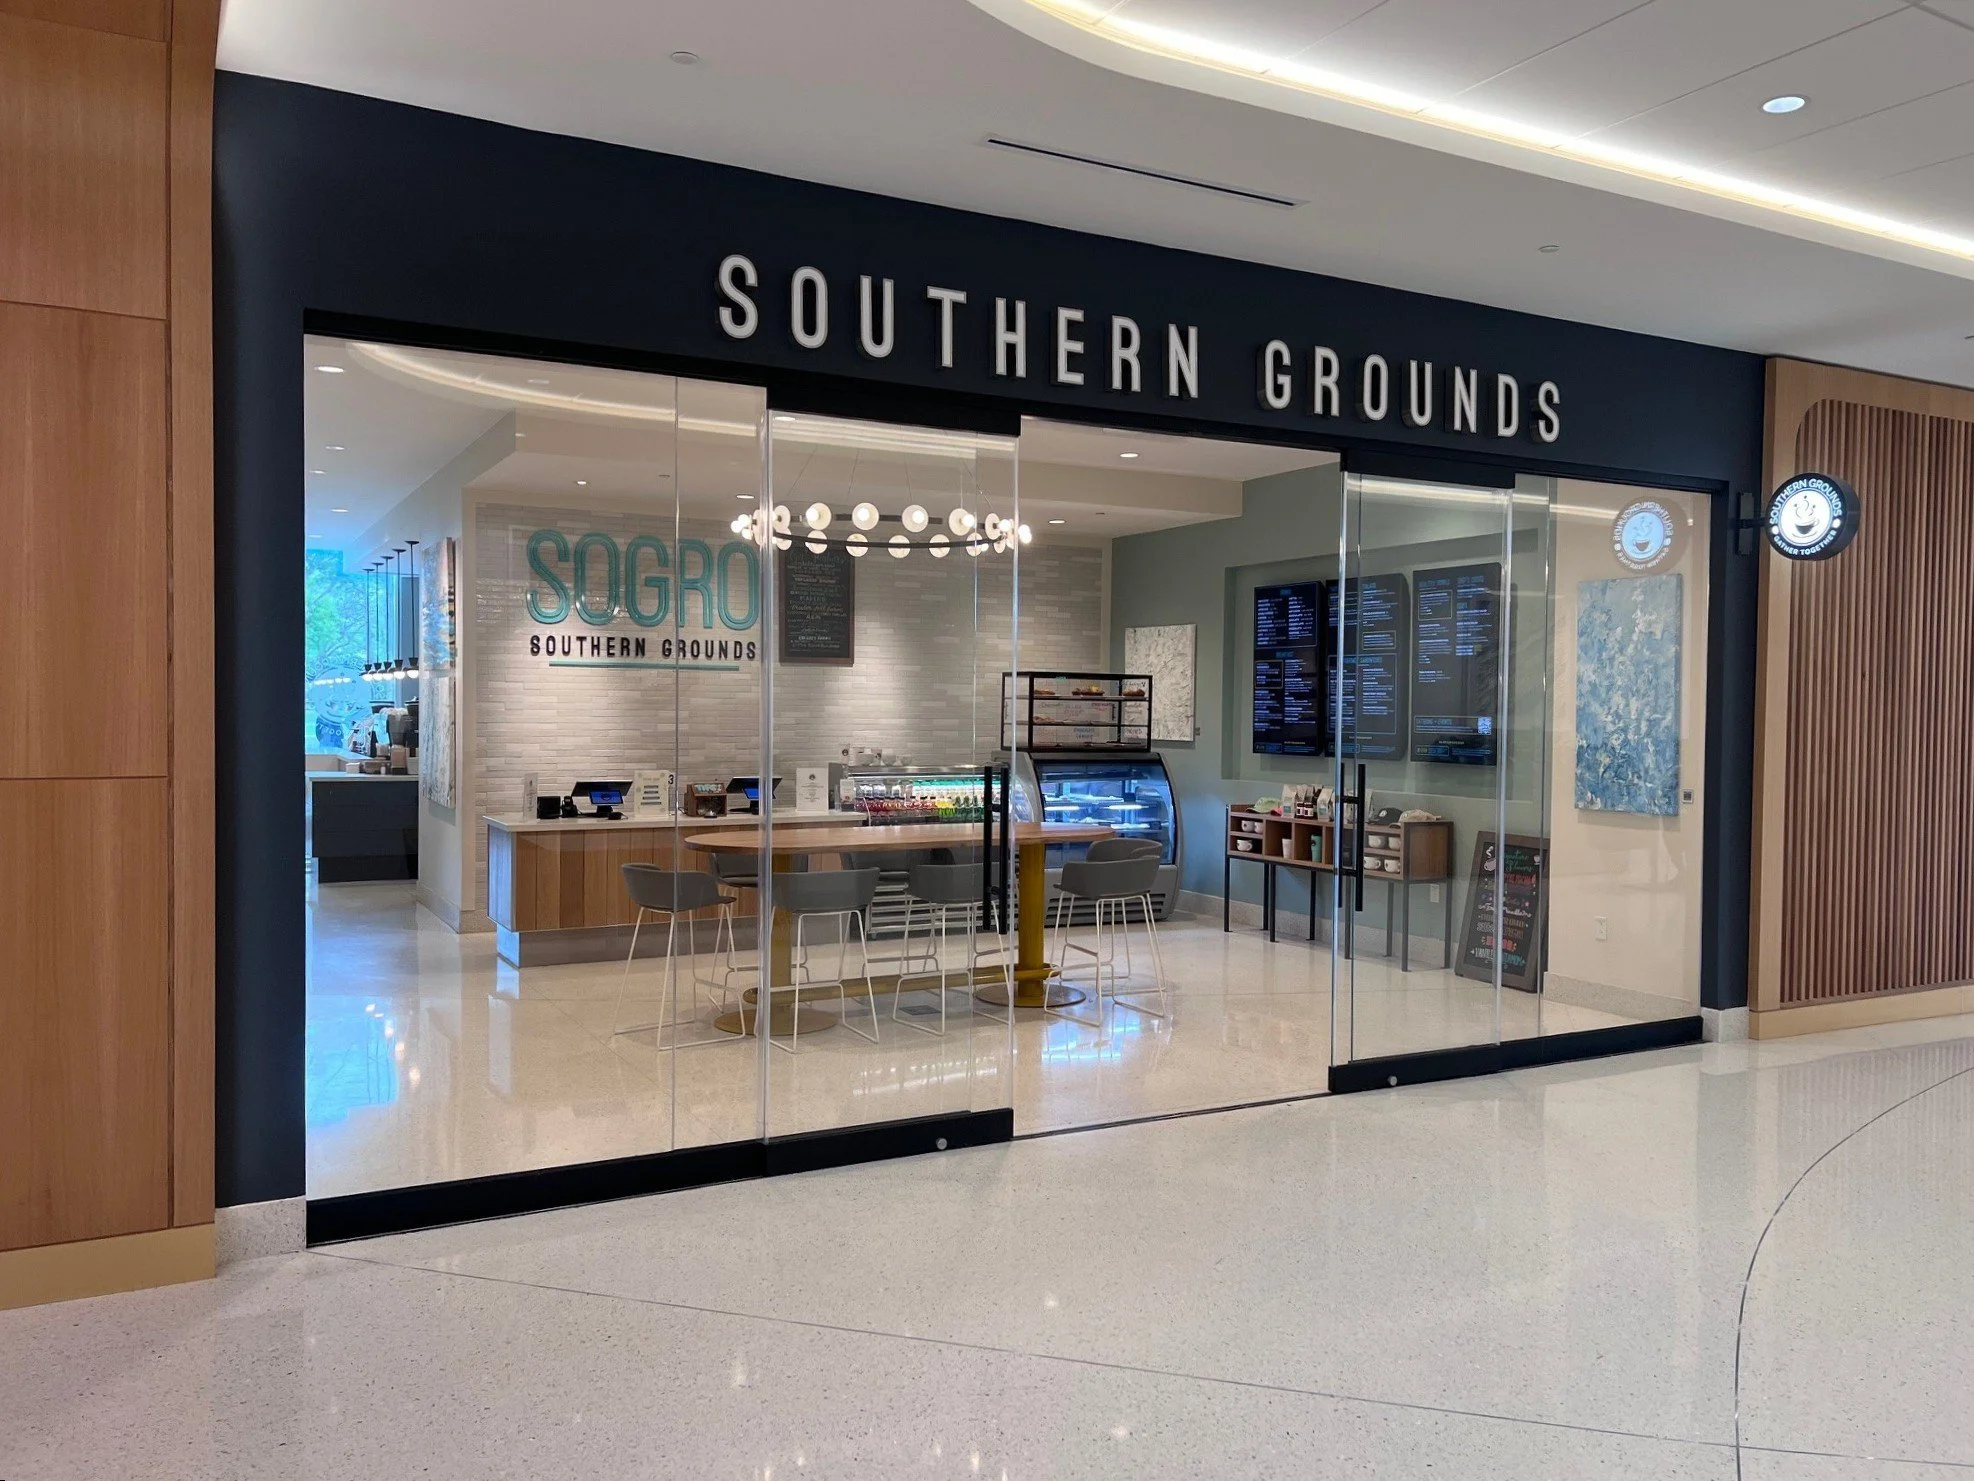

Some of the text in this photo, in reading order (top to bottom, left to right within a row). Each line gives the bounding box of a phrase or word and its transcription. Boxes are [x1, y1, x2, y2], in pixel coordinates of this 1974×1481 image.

[718, 254, 1561, 443] SOUTHERN GROUNDS
[1769, 478, 1843, 525] SOUTHERN GROUNDS
[1773, 530, 1838, 556] GATHER TOGETHER
[526, 529, 760, 631] SOGRO
[530, 635, 756, 660] SOUTHERN GROUNDS
[667, 774, 674, 785] 3
